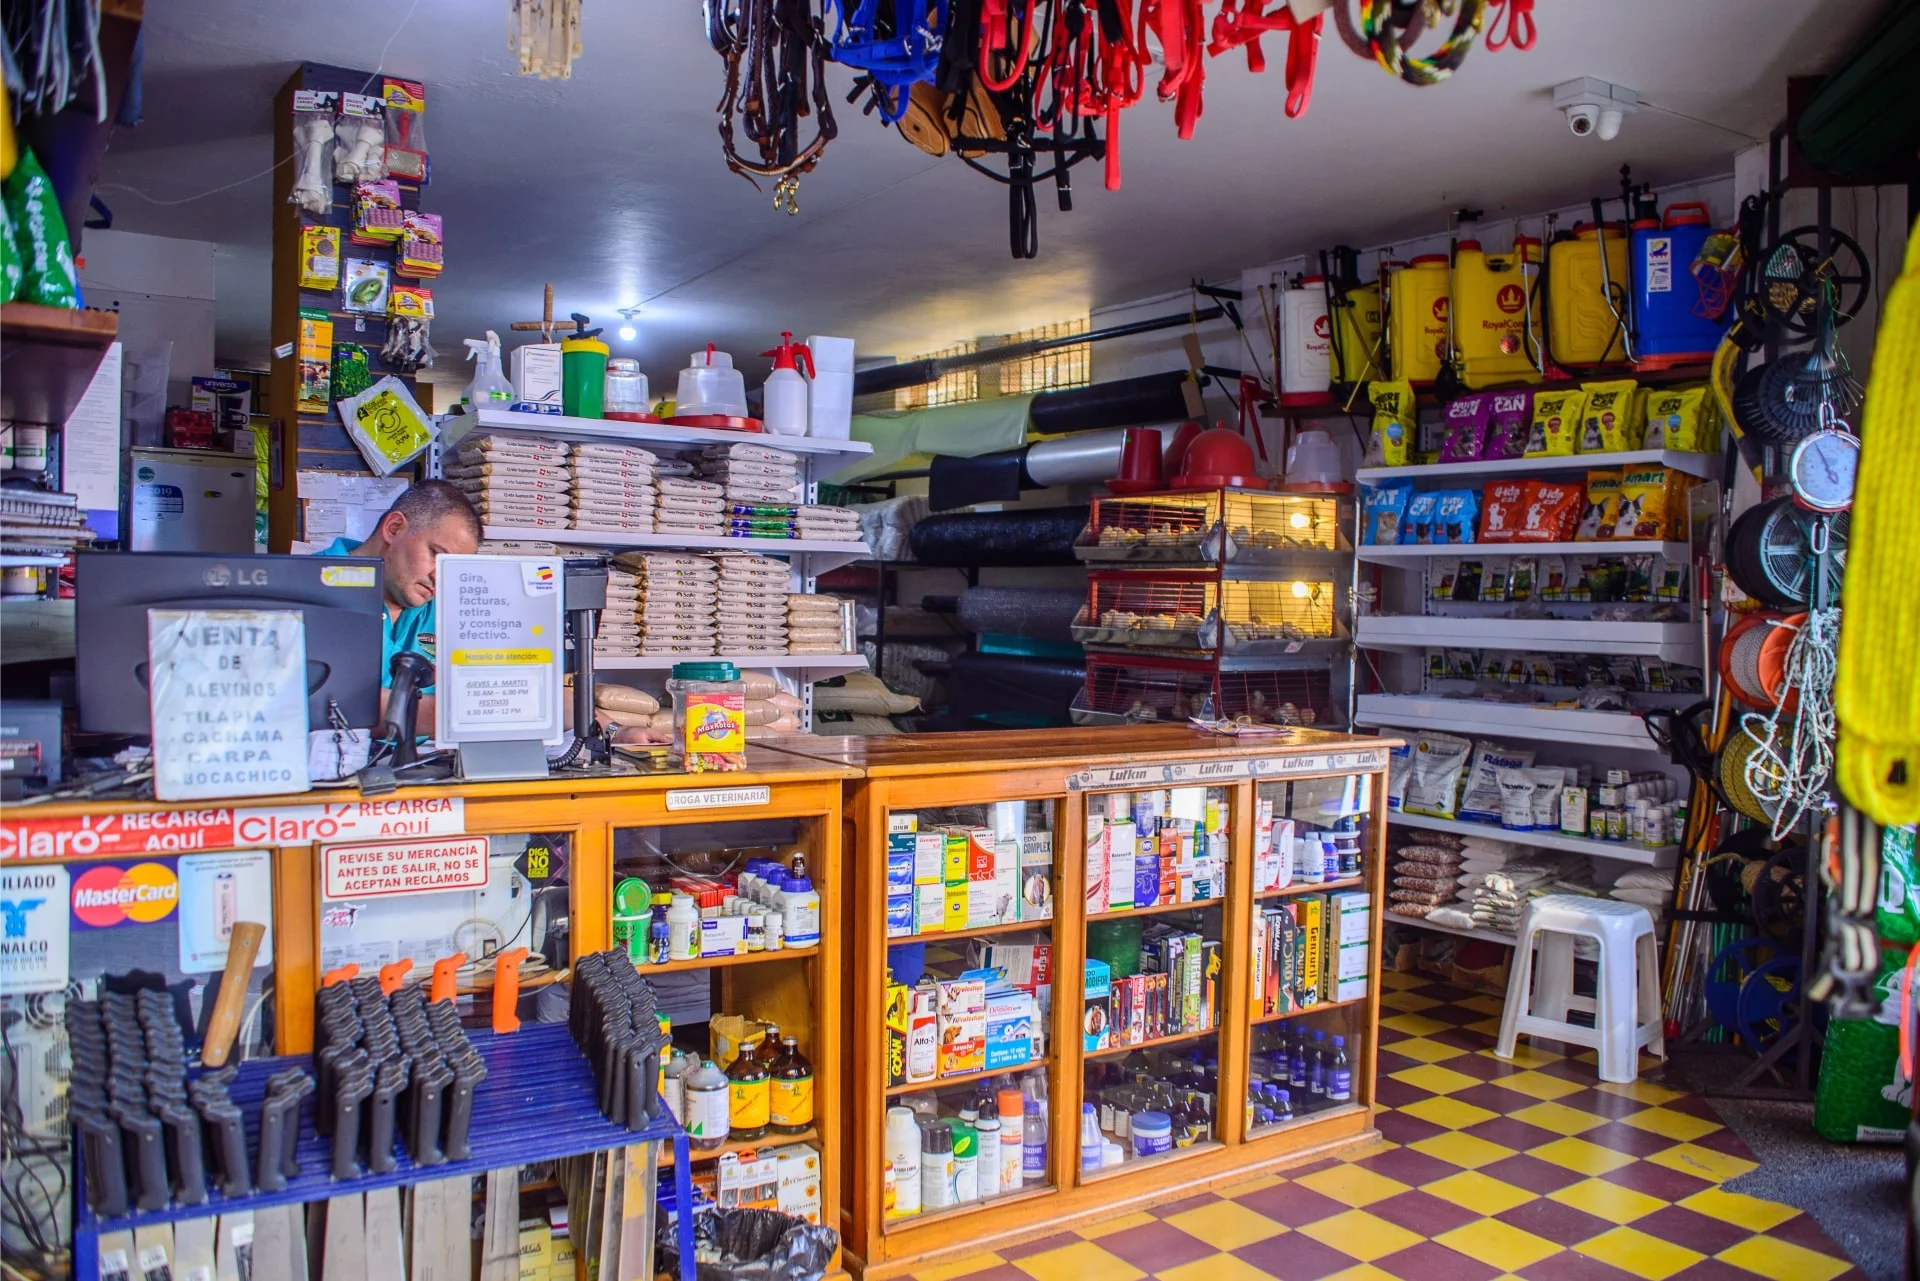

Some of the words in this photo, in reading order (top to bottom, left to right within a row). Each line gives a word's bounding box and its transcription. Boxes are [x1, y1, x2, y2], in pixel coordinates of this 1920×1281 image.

[1494, 399, 1526, 413] CAN
[1623, 471, 1665, 484] smart
[148, 487, 172, 496] 2019
[237, 570, 268, 586] LG
[459, 573, 487, 584] Gira,
[459, 586, 489, 596] paga
[459, 596, 510, 606] facturas,
[459, 608, 491, 617] retira
[459, 620, 467, 629] y
[470, 619, 522, 630] consigna
[182, 625, 281, 651] VENTA
[459, 630, 510, 640] efectivo.
[218, 655, 243, 670] DE
[465, 652, 493, 661] Horario
[494, 652, 504, 660] de
[185, 681, 277, 698] ALEVINOS
[183, 711, 266, 724] TILAPIA
[183, 729, 284, 744] CACHAMA
[187, 749, 272, 764] CARPA
[1109, 768, 1147, 782] Lufkin
[1198, 763, 1234, 775] Lufkin
[1282, 758, 1314, 769] Lufkin
[1356, 752, 1378, 764] Lufk
[669, 793, 701, 806] DROGA
[703, 790, 767, 805] VETERINARIA
[359, 797, 453, 817] RECARGA
[122, 808, 231, 831] RECARGA
[380, 817, 430, 836] AQUÍ
[239, 815, 338, 843] Claro
[145, 831, 204, 851] AQUÍ
[1023, 841, 1051, 854] COMPLEX
[339, 852, 383, 864] REVISE
[387, 851, 404, 861] SU
[408, 844, 478, 859] MERCANCÍA
[528, 848, 548, 856] DIGA
[337, 866, 378, 878] ANTES
[382, 865, 398, 875] DE
[402, 862, 440, 874] SALIR,
[444, 860, 461, 870] NO
[465, 859, 479, 868] SE
[528, 856, 549, 868] NO
[2, 873, 56, 890] ILIADO
[345, 878, 401, 891] ACEPTAN
[405, 873, 470, 886] RECLAMOS
[75, 882, 177, 909] MasterCard
[0, 939, 48, 955] NALCO
